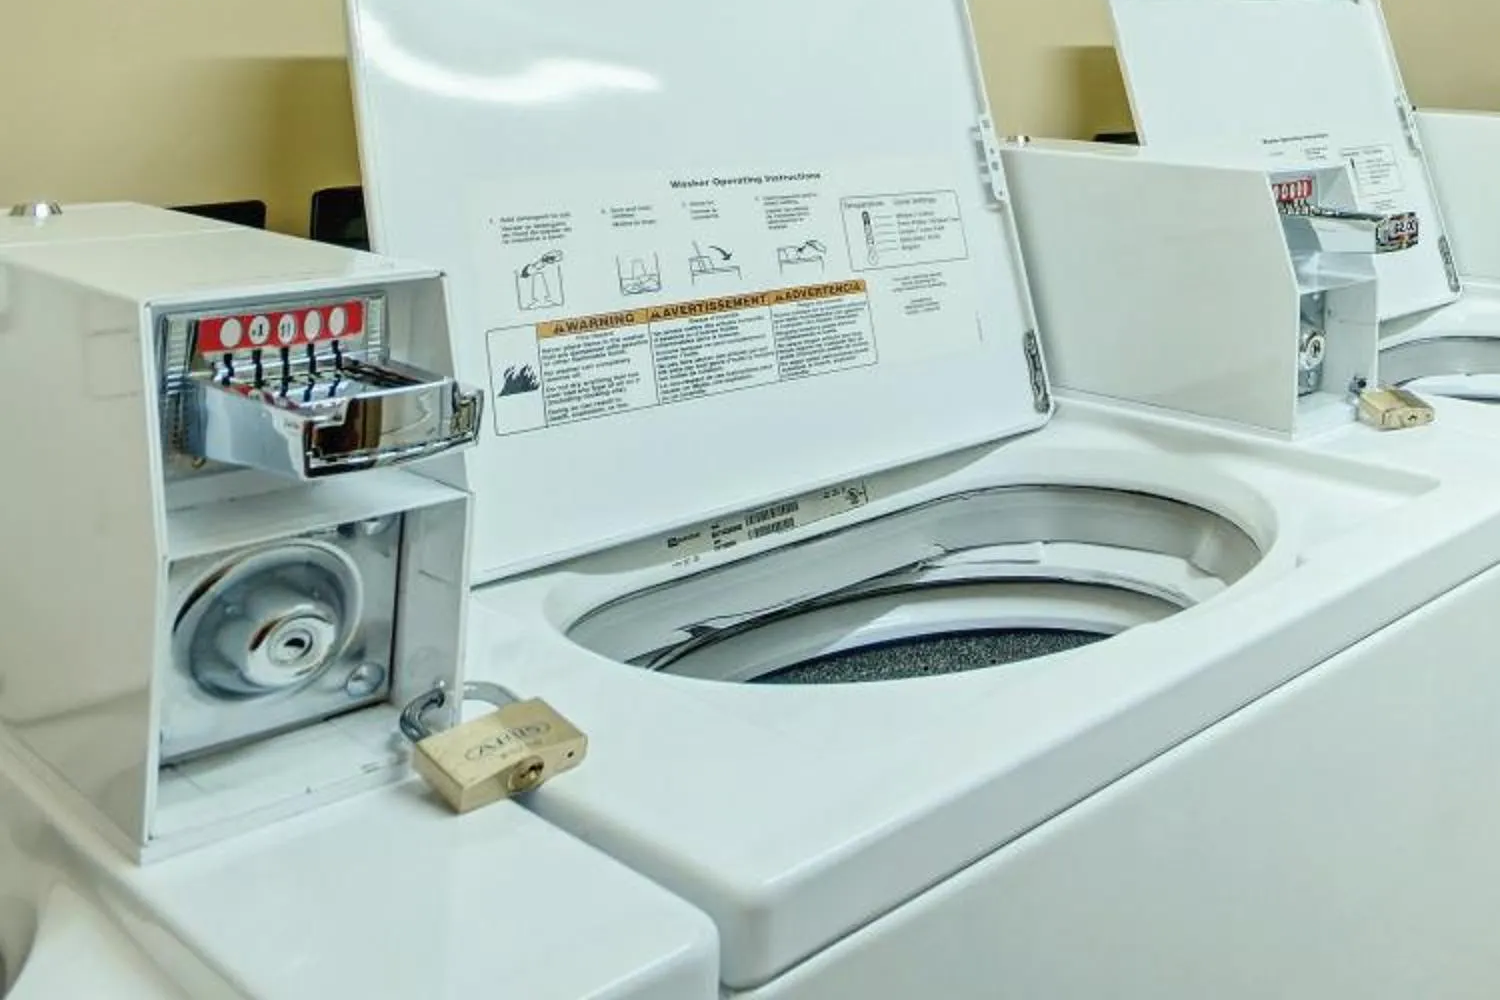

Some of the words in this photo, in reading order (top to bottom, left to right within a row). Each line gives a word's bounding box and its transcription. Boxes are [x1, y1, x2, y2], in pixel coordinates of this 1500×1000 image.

[669, 178, 709, 189] Washer
[712, 174, 763, 188] Operating
[566, 313, 634, 331] WARNING
[663, 296, 765, 316] AVERTISSEMENT
